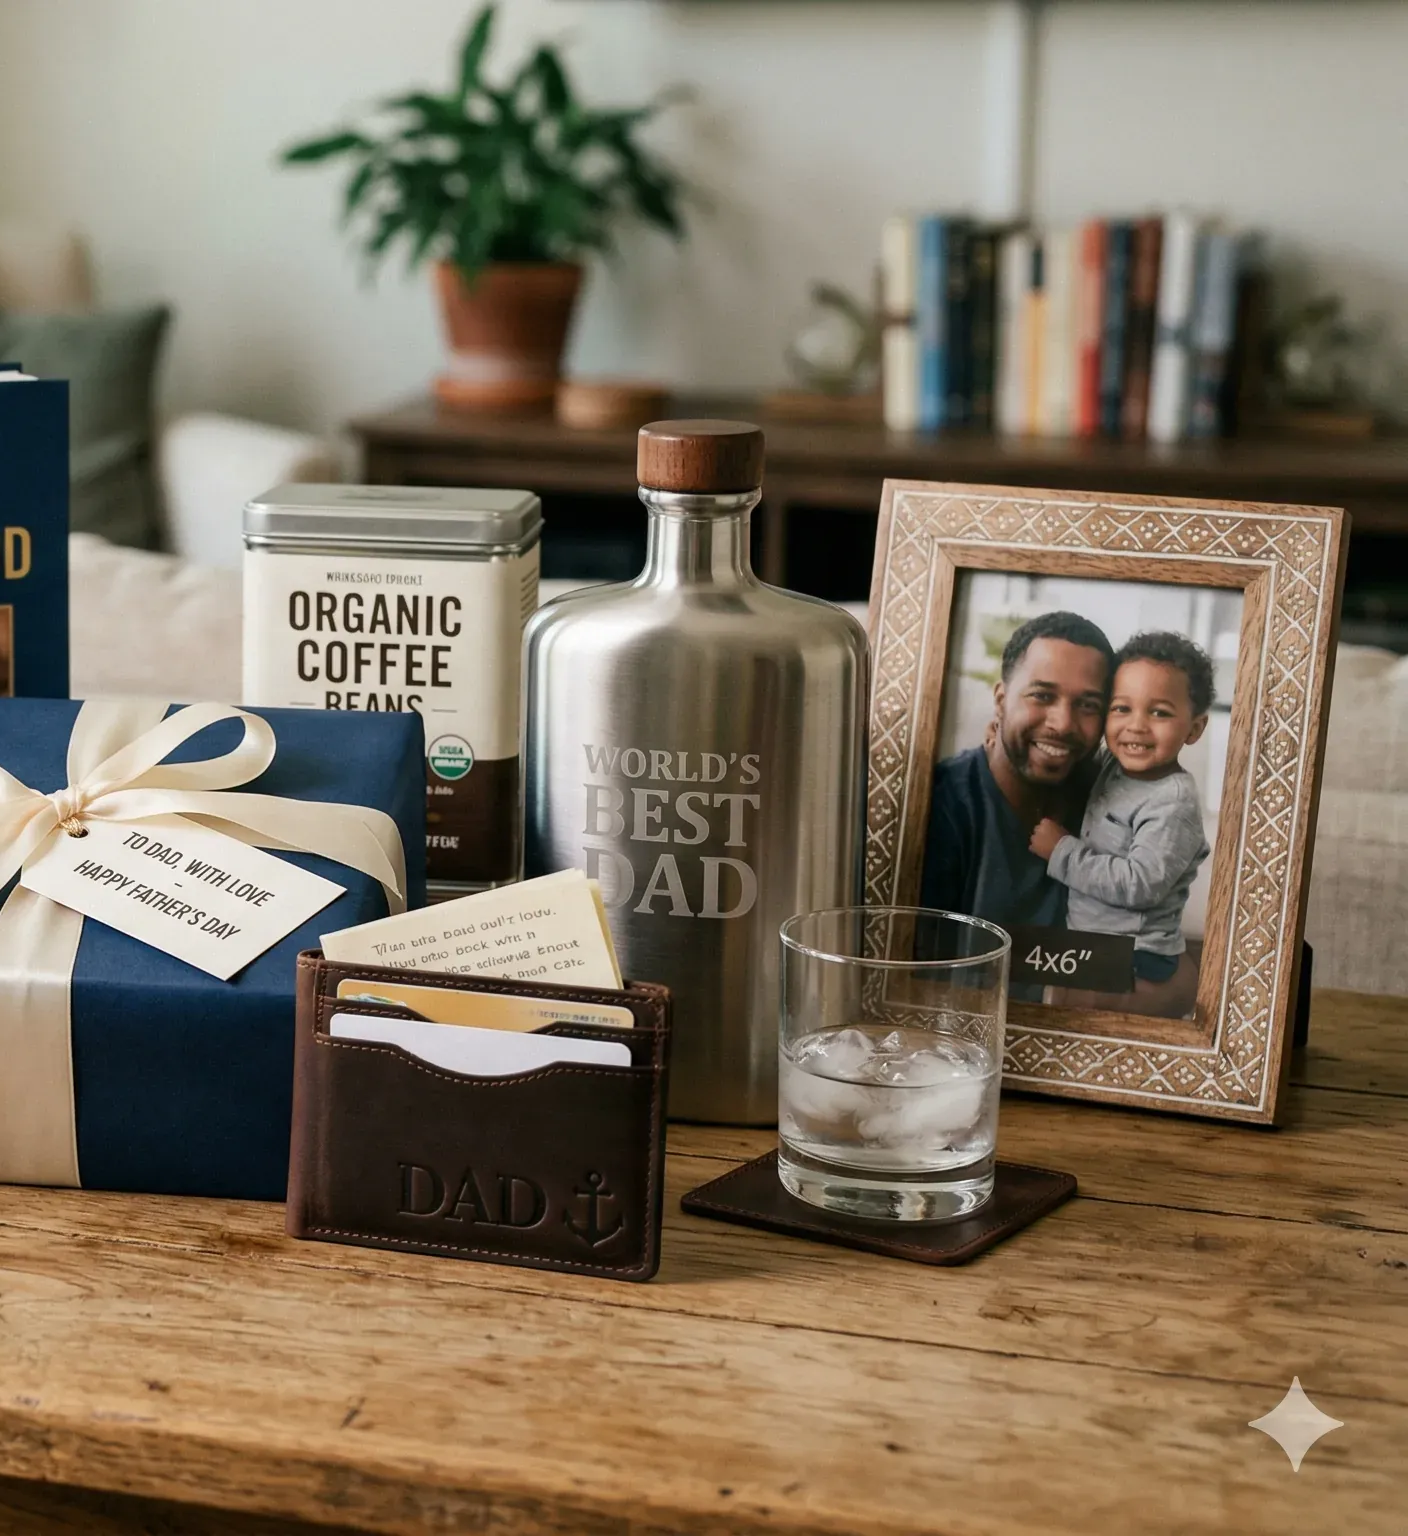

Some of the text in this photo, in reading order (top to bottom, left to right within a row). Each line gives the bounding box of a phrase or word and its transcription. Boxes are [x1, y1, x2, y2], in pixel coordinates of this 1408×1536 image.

[288, 590, 462, 637] ORGANIC
[297, 639, 452, 687] COFFEE
[582, 743, 760, 784] WORLD'S
[582, 783, 761, 847] BEST
[73, 859, 242, 941] HAPPY FATHER'S DAY
[122, 831, 275, 907] TO DAD, WITH LOVE
[582, 846, 758, 919] DAD
[396, 1162, 550, 1230] DAD
